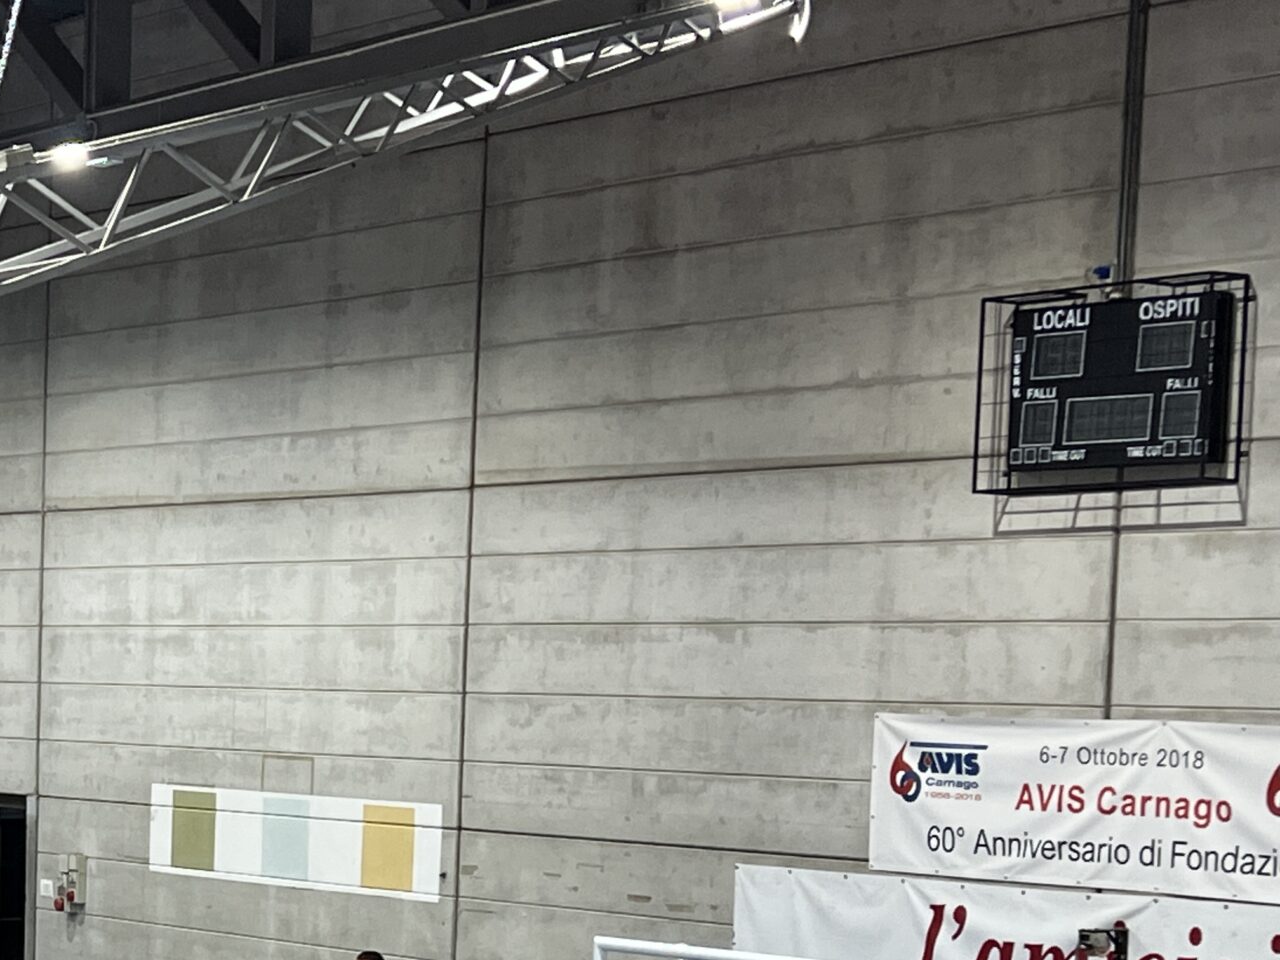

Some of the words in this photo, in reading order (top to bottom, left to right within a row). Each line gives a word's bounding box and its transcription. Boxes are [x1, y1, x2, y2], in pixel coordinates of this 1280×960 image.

[1032, 307, 1091, 330] LOCALI
[1138, 297, 1200, 320] OSPITI
[1026, 387, 1057, 400] FALLI
[917, 750, 980, 776] AVIS
[1038, 745, 1067, 765] 6-7
[1076, 745, 1149, 768] Ottobre
[1156, 748, 1205, 770] 2018
[1014, 782, 1085, 815] AVIS
[1096, 785, 1233, 829] Carnago
[926, 824, 965, 854] 60°
[973, 828, 1131, 866] Anniversario
[1138, 837, 1162, 868] di
